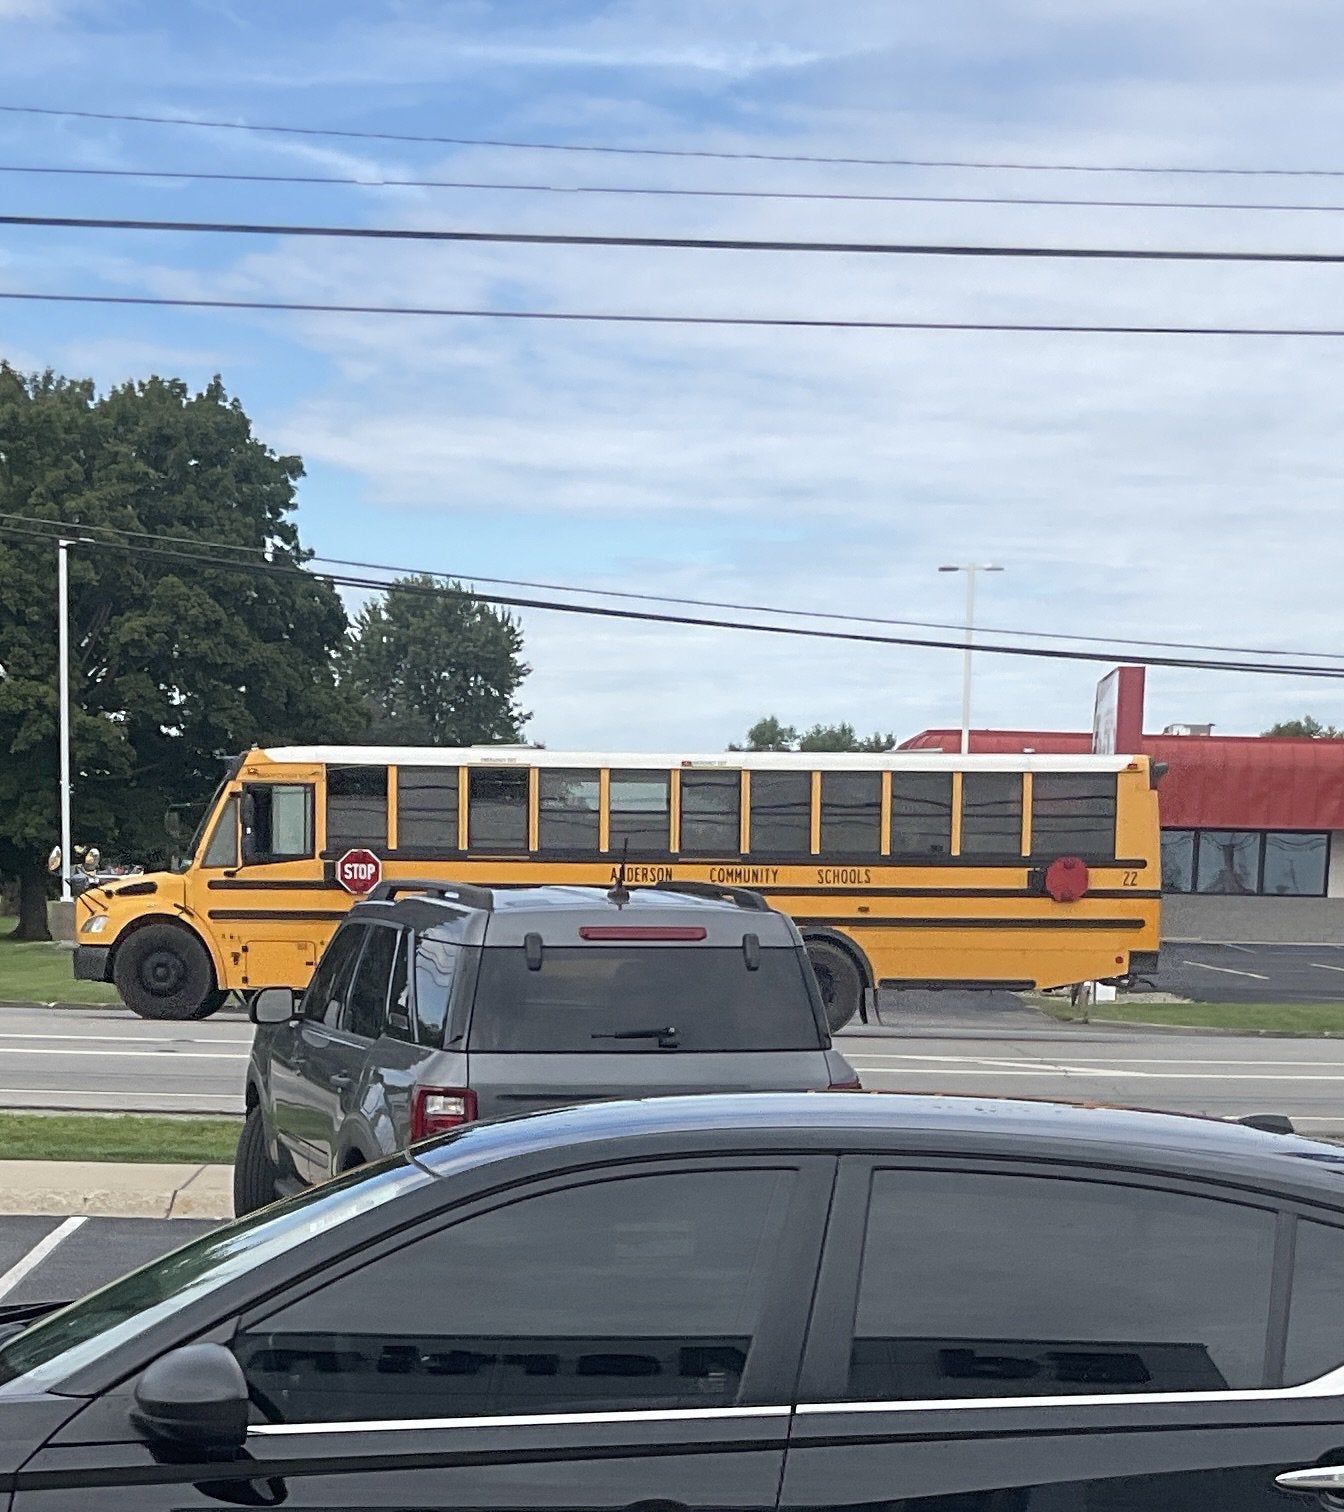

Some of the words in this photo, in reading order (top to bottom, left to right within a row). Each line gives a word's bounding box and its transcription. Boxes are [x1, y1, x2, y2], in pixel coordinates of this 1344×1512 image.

[344, 863, 376, 880] STOP
[709, 867, 779, 884] COMMUNITY
[817, 869, 871, 884] SCHOOLS
[1122, 871, 1138, 887] 22
